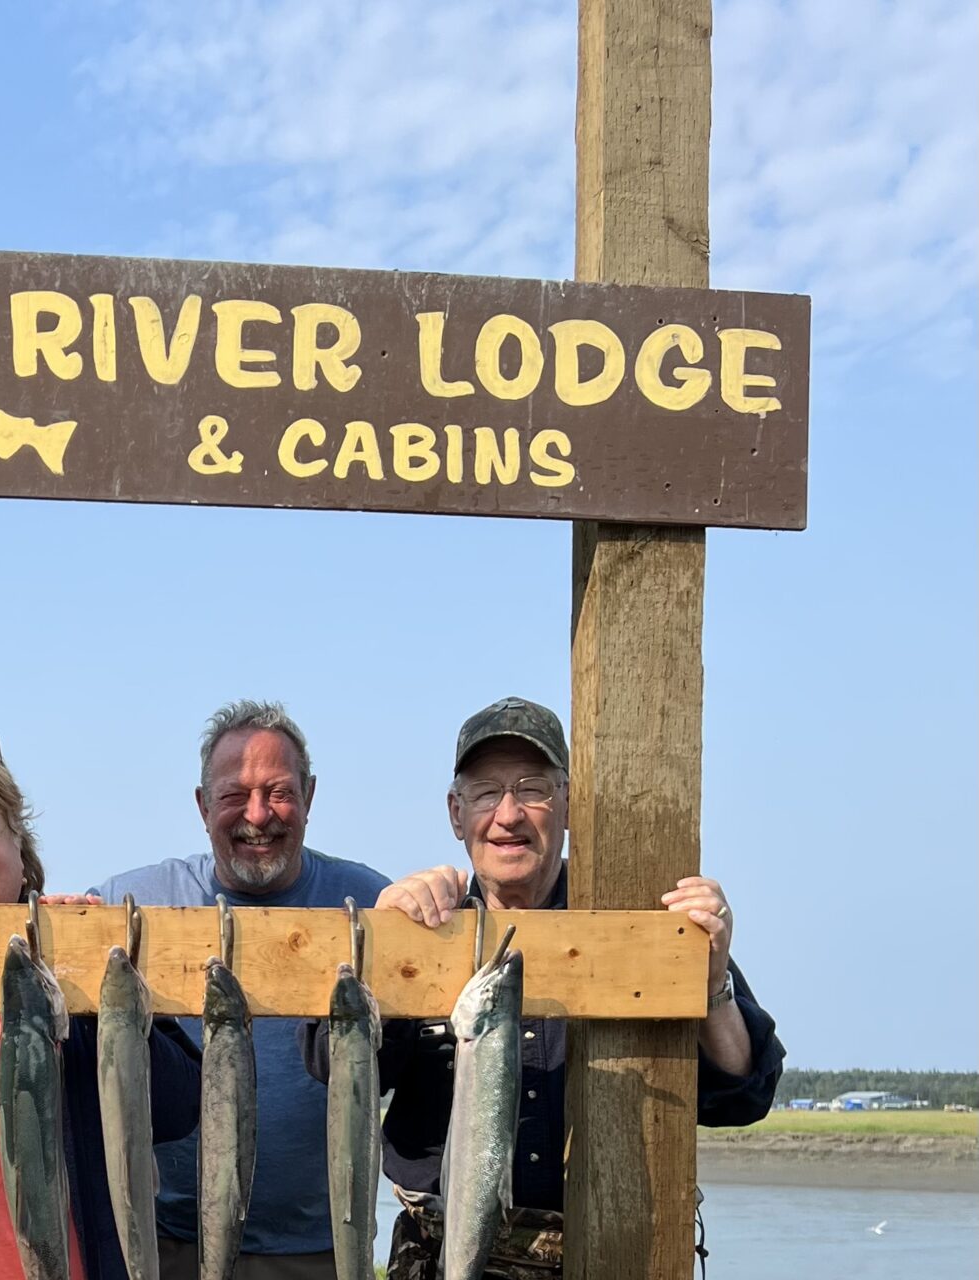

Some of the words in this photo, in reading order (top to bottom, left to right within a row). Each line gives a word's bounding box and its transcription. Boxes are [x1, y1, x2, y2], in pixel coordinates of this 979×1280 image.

[10, 290, 363, 393] RIVER
[415, 311, 783, 416] LODGE
[187, 414, 244, 475] &
[278, 418, 576, 489] CABINS
